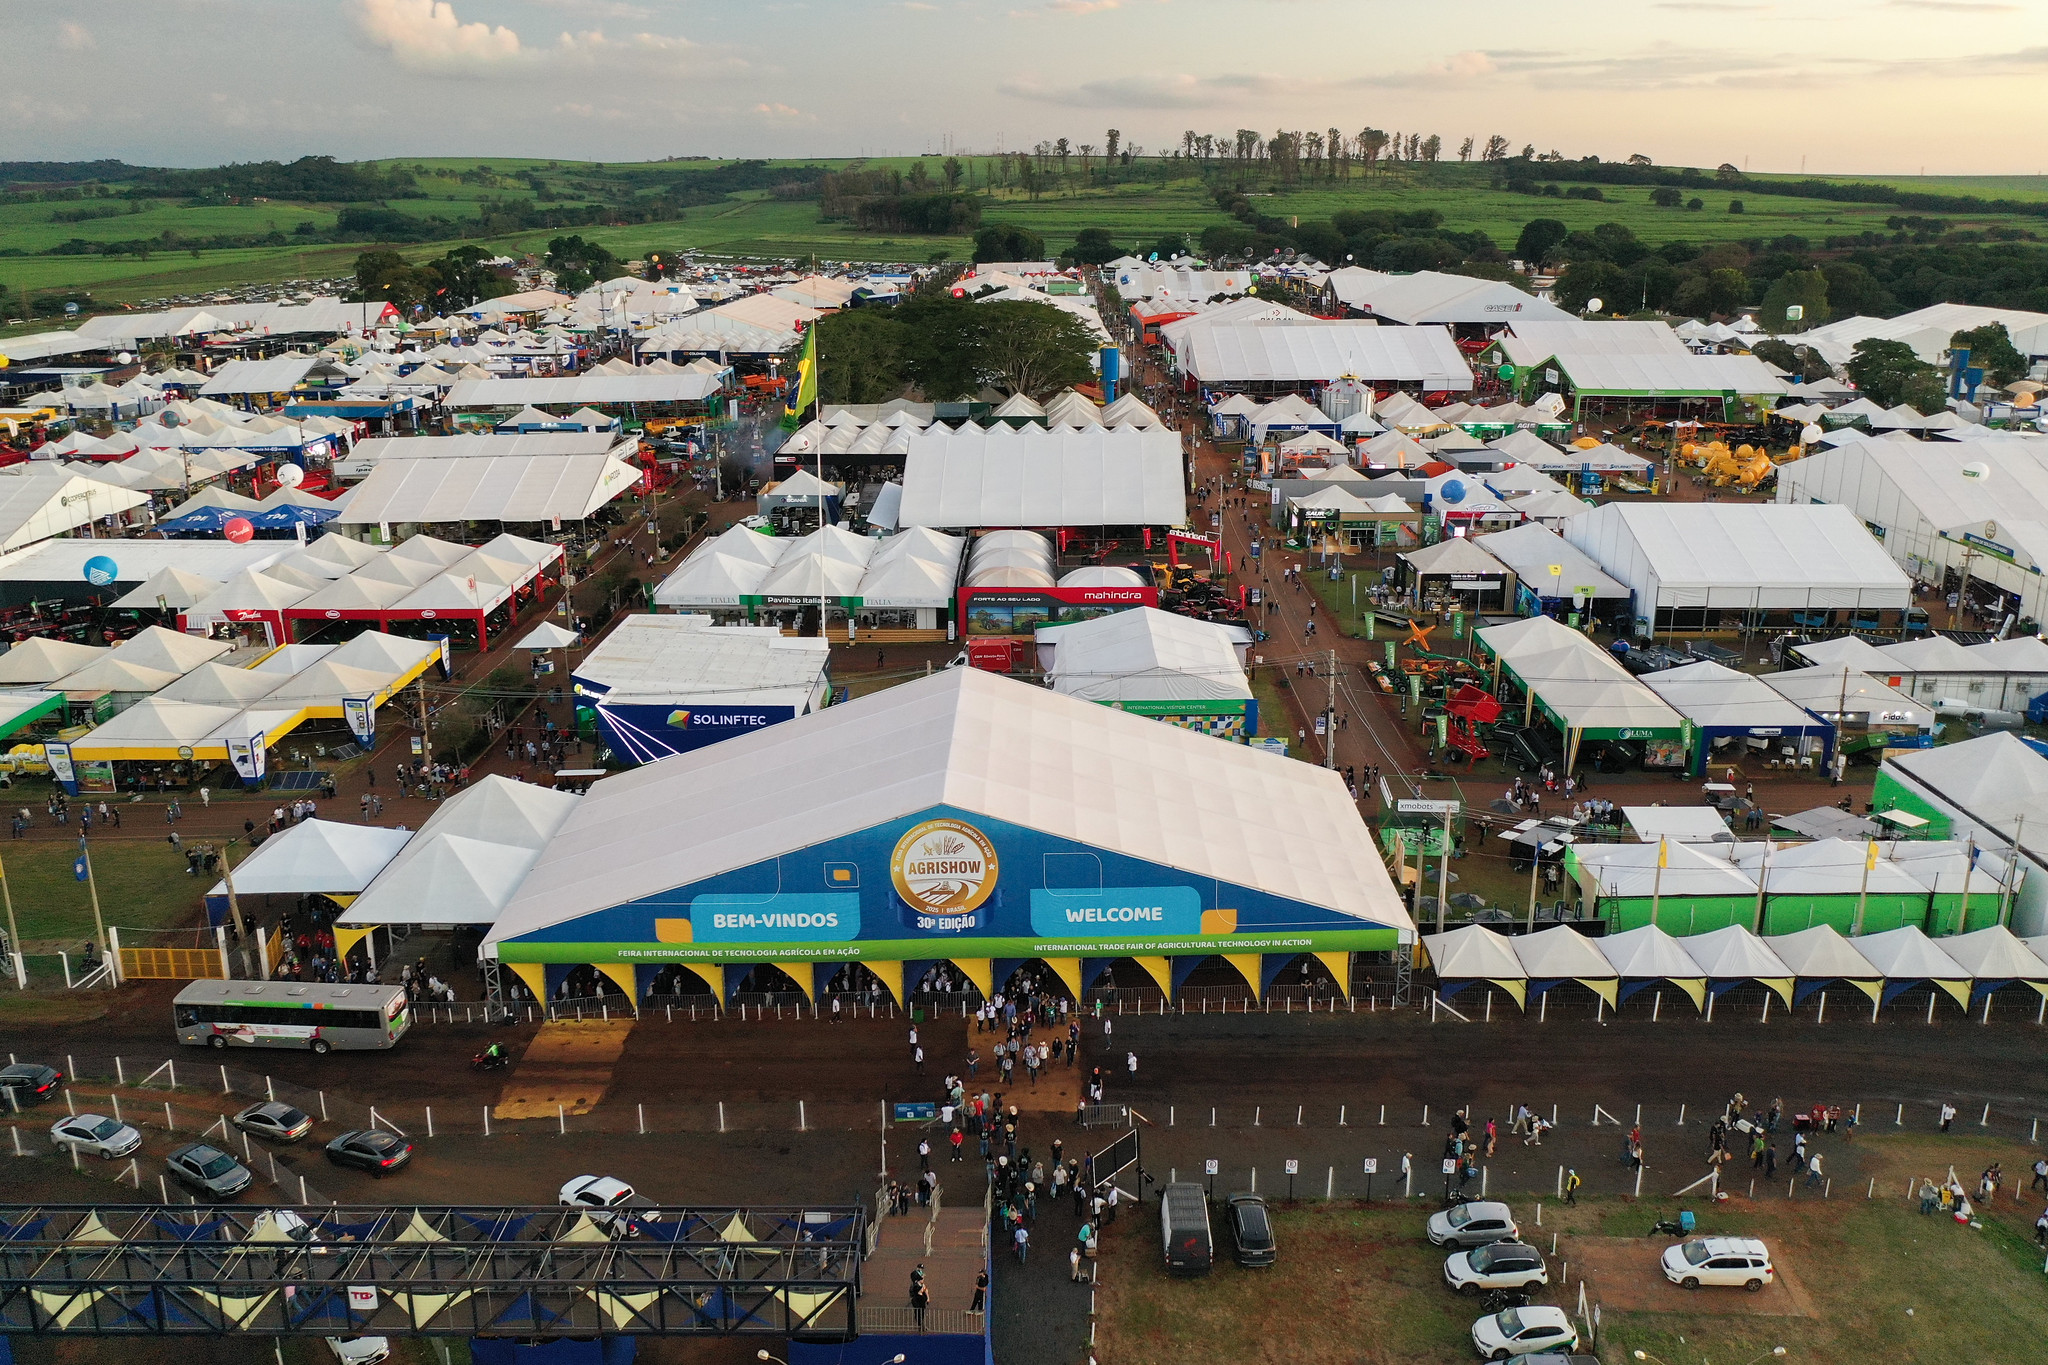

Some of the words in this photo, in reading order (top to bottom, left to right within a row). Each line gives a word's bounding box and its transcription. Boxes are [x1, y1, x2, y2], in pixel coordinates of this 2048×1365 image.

[1484, 304, 1511, 312] CASE
[1083, 591, 1142, 600] mahindra
[693, 714, 766, 725] SOLINFTEC
[1400, 802, 1434, 810] xmobots
[934, 822, 961, 831] TECNOLOGIA
[908, 860, 981, 876] AGRISHOW
[925, 905, 940, 914] 2025
[946, 905, 967, 914] BRASIL
[1065, 907, 1164, 923] WELCOME
[713, 913, 839, 928] BEM-VINDOS
[938, 913, 976, 933] EDIÇÃO
[1157, 941, 1217, 949] AGRICULTURAL
[1217, 939, 1271, 948] TECHNOLOGY
[1281, 938, 1312, 946] ACTION
[724, 949, 778, 957] TECNOLOGIA
[779, 947, 822, 956] AGRÍCOLA
[822, 948, 836, 956] EM
[836, 946, 861, 957] AÇÃO
